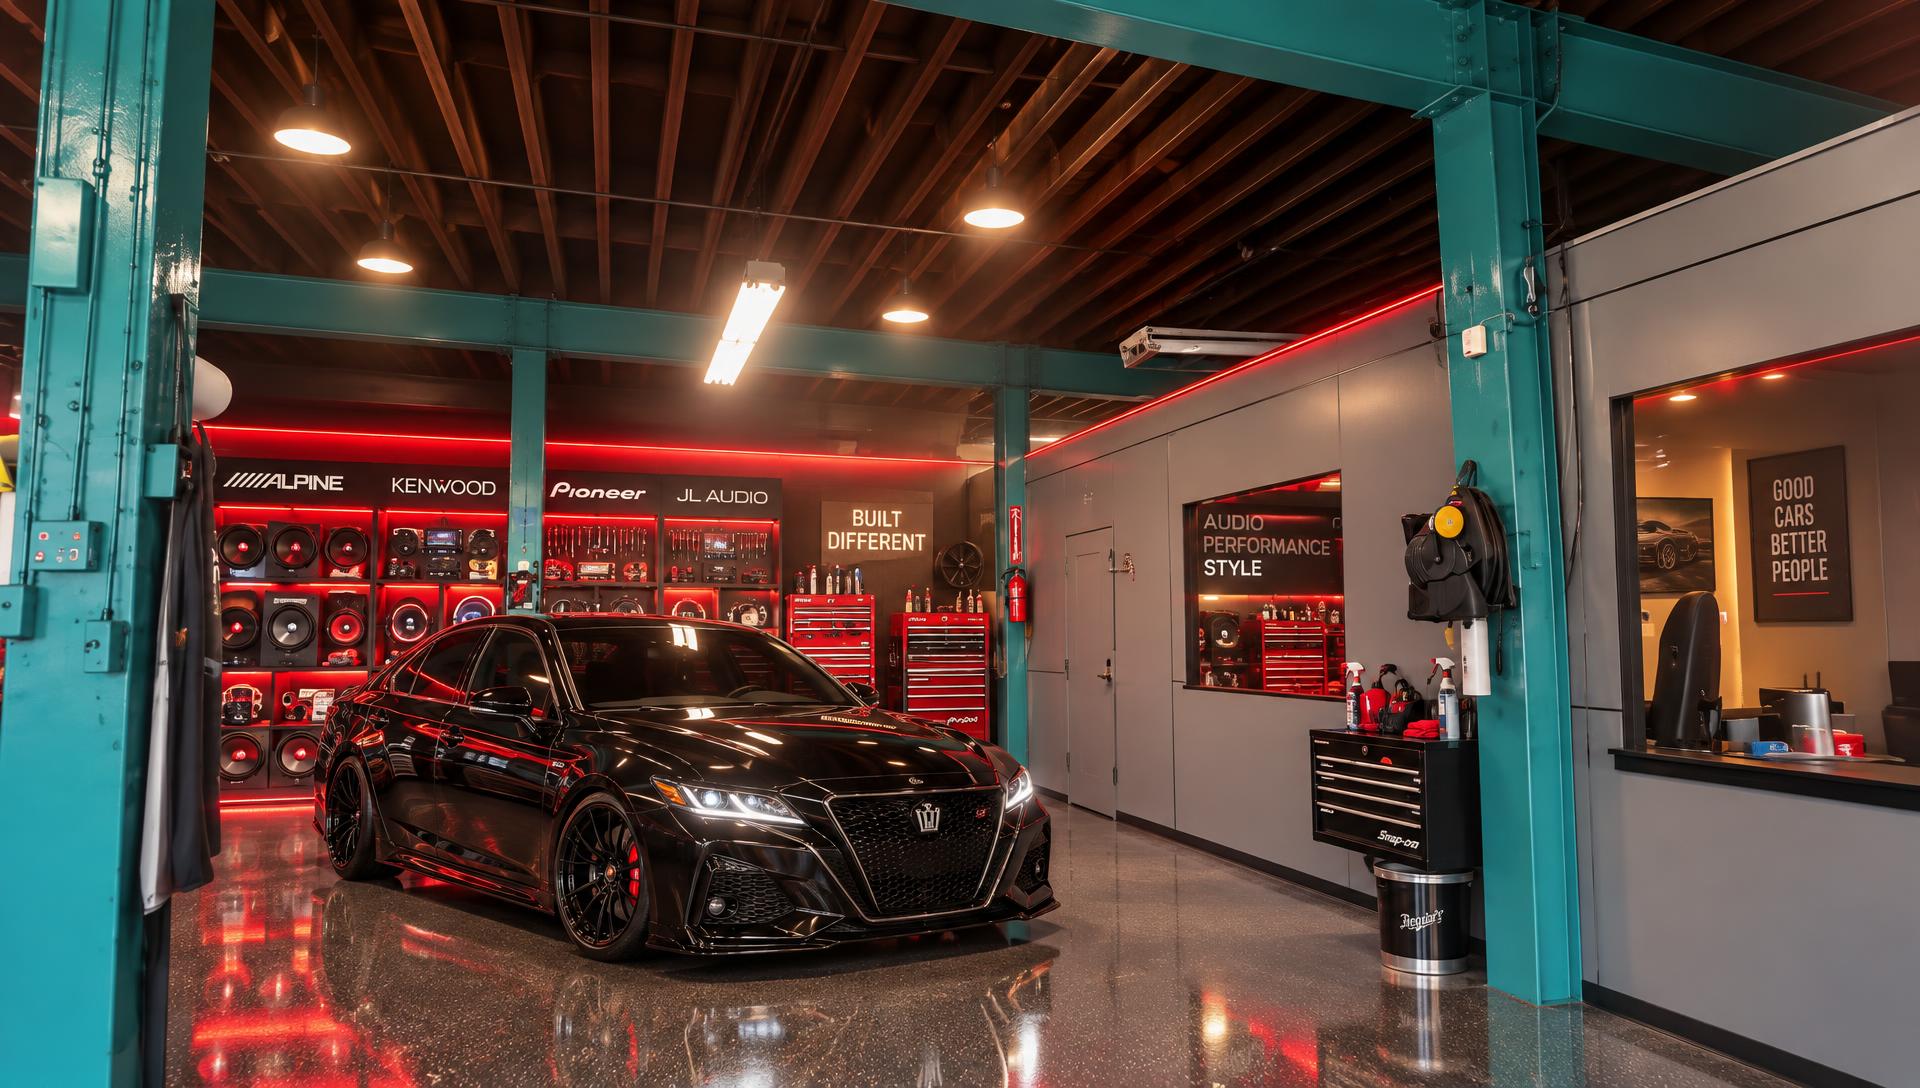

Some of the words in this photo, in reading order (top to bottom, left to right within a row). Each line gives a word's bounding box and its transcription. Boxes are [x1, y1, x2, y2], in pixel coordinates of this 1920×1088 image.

[262, 474, 344, 491] ALPINE
[391, 477, 497, 496] KENWOOD
[549, 481, 647, 500] Pioneer
[1772, 475, 1814, 502] GOOD
[676, 488, 702, 503] JL
[705, 489, 768, 505] AUDIO
[852, 509, 903, 527] BUILT
[1203, 513, 1264, 531] AUDIO
[1774, 503, 1815, 528] CARS
[827, 531, 926, 551] DIFFERENT
[1203, 535, 1331, 556] PERFORMANCE
[1771, 530, 1828, 556] BETTER
[1203, 559, 1262, 577] STYLE
[1772, 557, 1828, 583] PEOPLE
